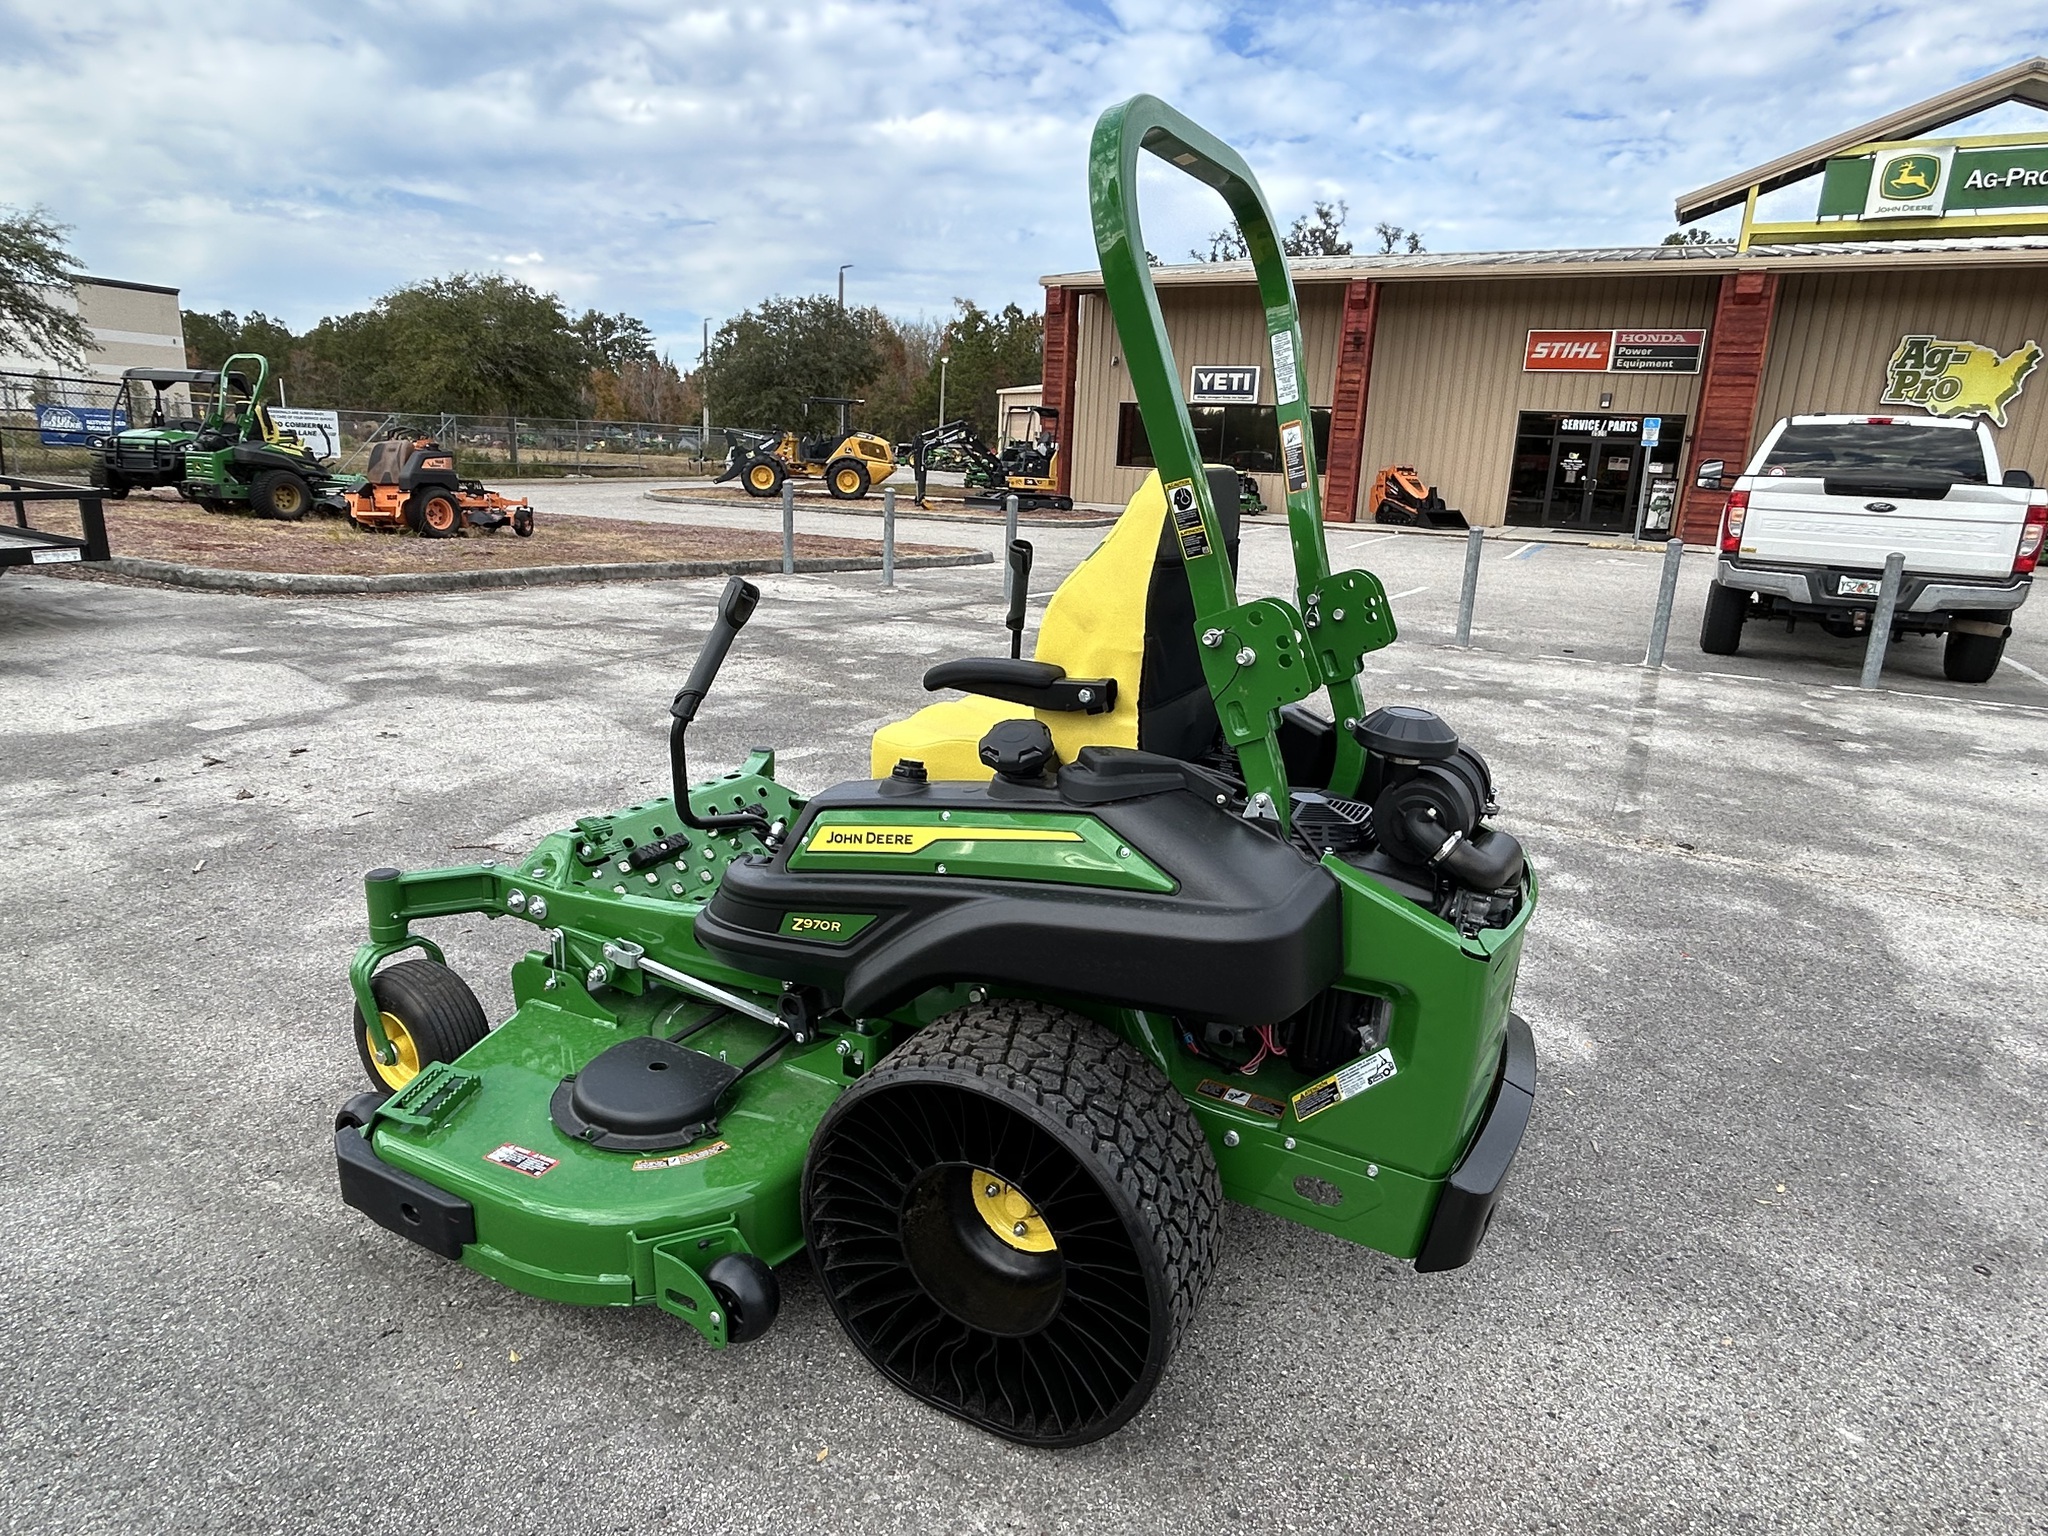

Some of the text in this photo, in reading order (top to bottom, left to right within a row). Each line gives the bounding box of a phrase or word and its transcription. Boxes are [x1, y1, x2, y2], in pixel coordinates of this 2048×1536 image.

[1875, 204, 1934, 214] JOHN DEERE
[1620, 333, 1686, 343] HONDA
[1531, 342, 1603, 359] STIHL
[1618, 346, 1653, 356] Power
[1616, 358, 1674, 369] Equipment
[1893, 338, 1969, 377] Ag-
[1198, 372, 1251, 391] YETI
[1885, 370, 1961, 401] Pro
[85, 419, 126, 427] AUTHORZED
[285, 421, 333, 429] COMMERAL
[1561, 419, 1600, 431] SERVICE
[1607, 420, 1638, 432] PARTS
[826, 831, 913, 845] JOHN DEERE
[791, 917, 841, 932] Z970R
